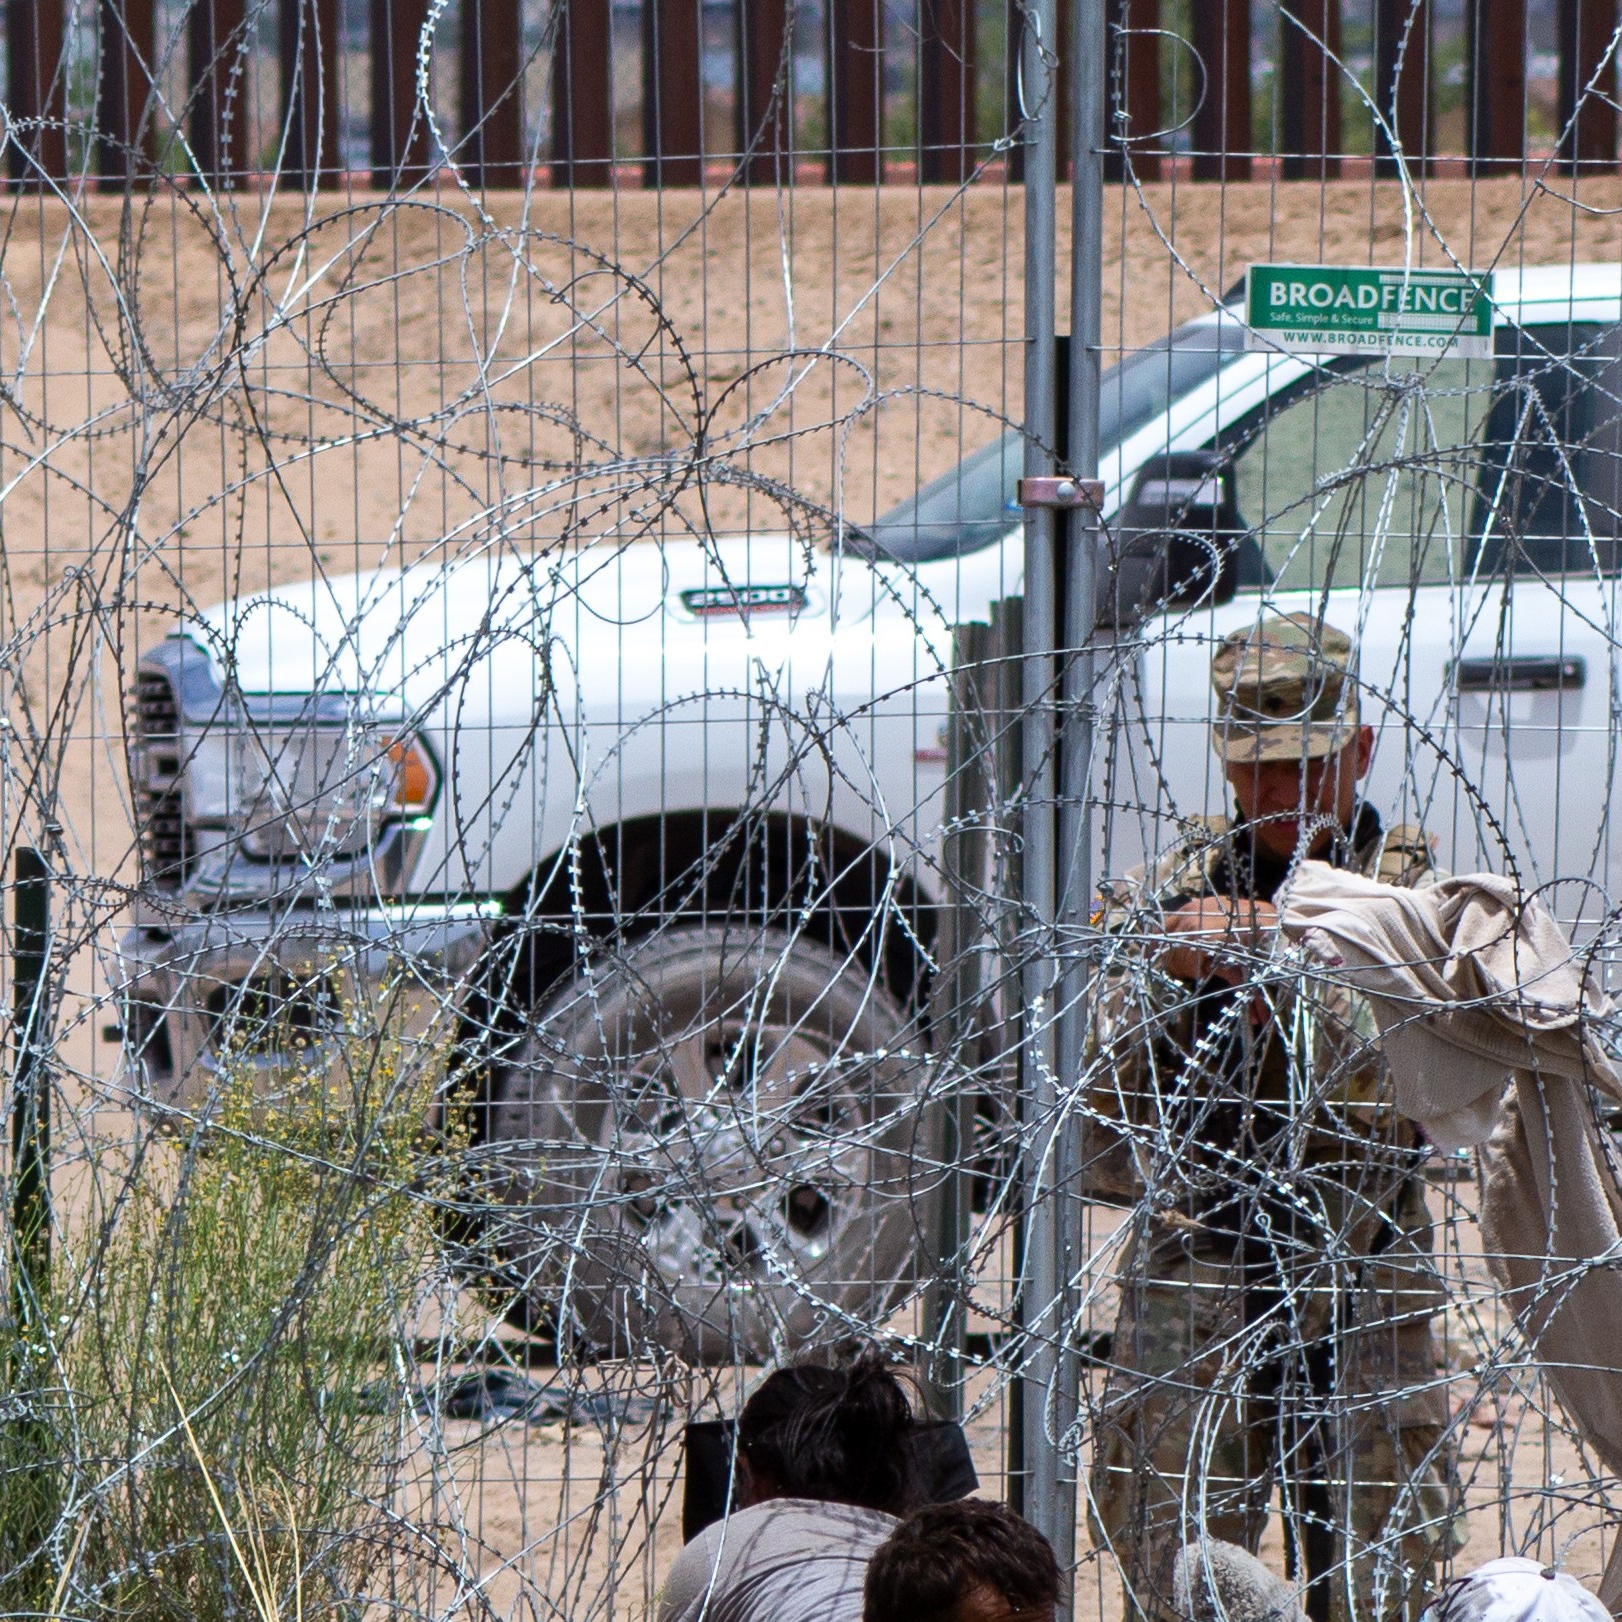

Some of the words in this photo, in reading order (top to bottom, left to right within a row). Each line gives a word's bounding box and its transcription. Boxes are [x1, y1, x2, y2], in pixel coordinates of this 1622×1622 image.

[1270, 281, 1476, 312] BROADFENCE
[1270, 311, 1293, 323] Safe,
[1295, 312, 1328, 325] Simple
[1331, 313, 1340, 324] &
[1341, 313, 1373, 325] Secure
[1283, 332, 1459, 349] WWW.BROADFENCE.COM
